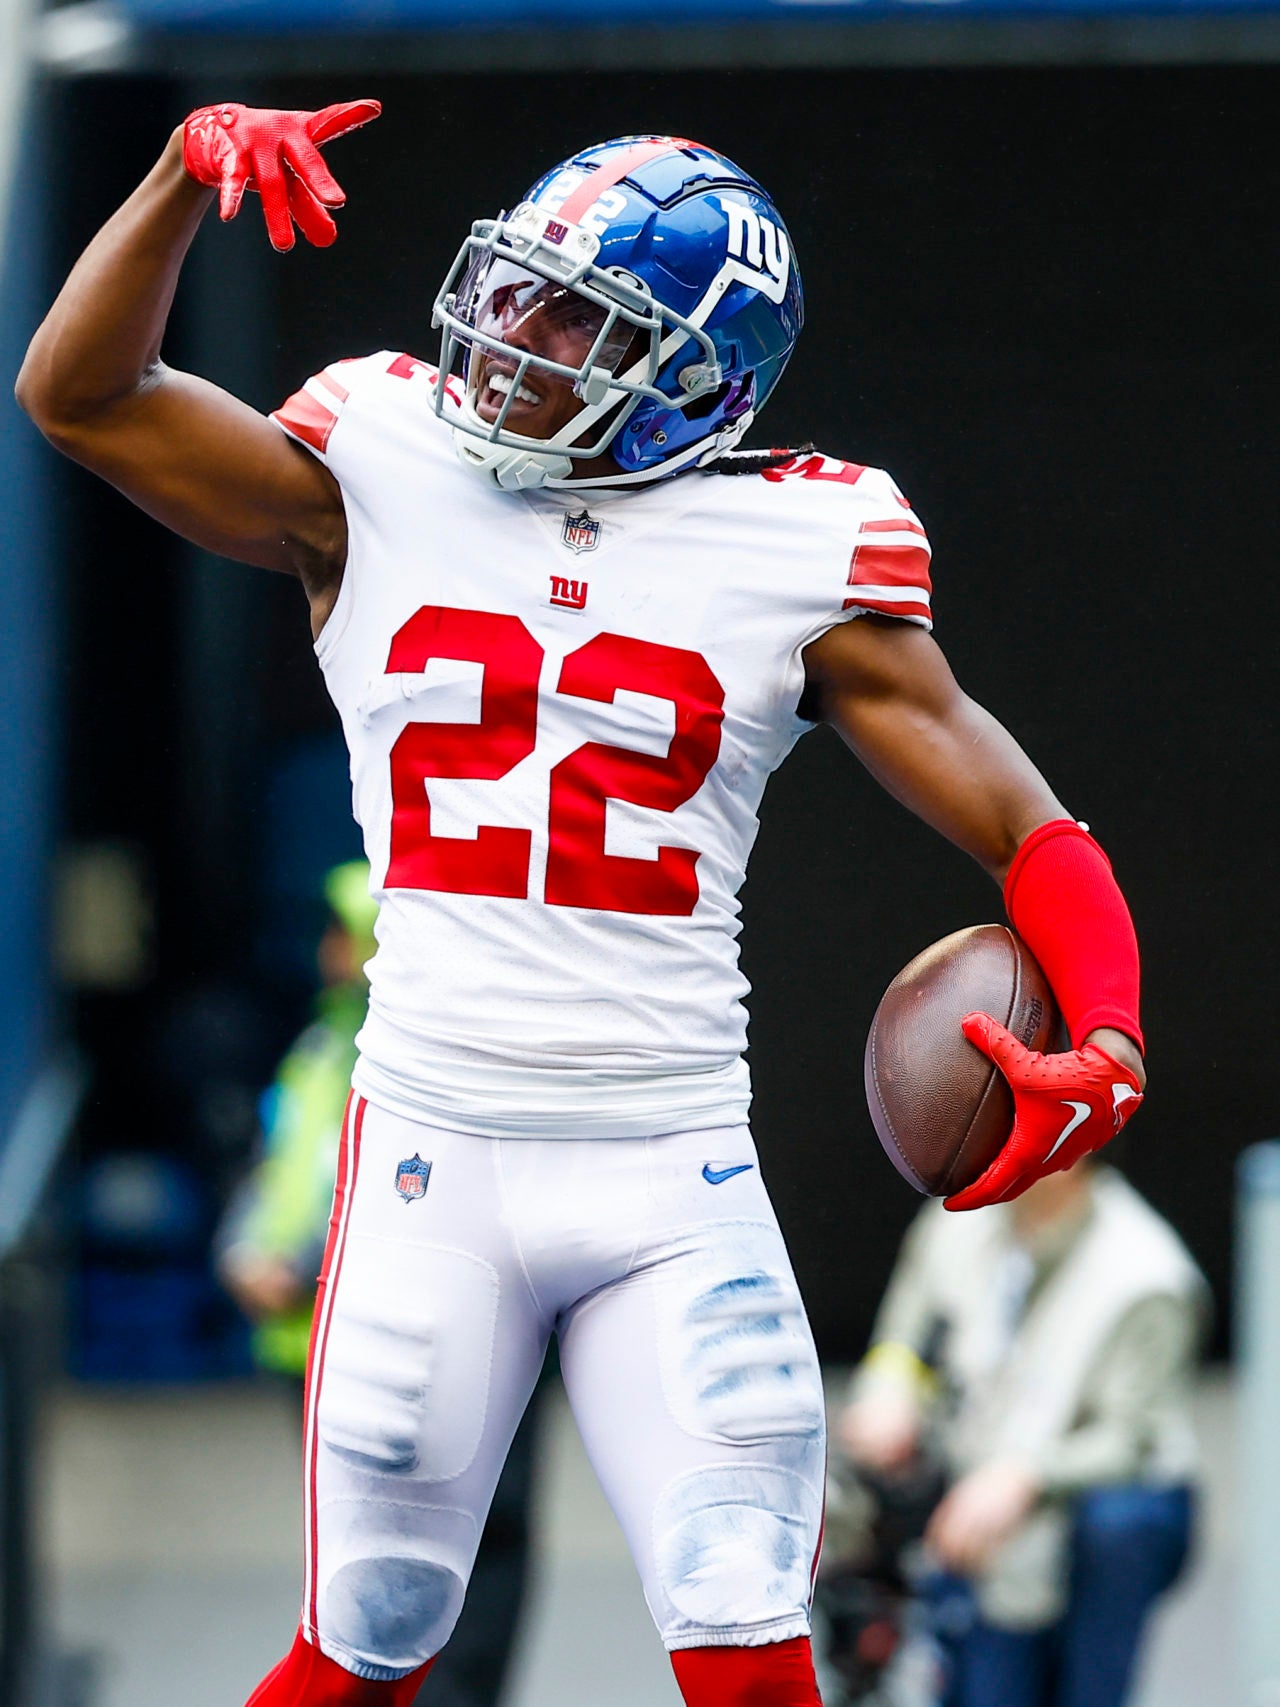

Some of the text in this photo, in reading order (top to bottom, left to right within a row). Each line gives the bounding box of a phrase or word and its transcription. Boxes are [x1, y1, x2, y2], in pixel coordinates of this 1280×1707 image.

[536, 170, 628, 237] 22
[720, 197, 790, 305] ny
[567, 527, 593, 545] NFL
[549, 575, 588, 610] ny
[384, 605, 726, 916] 22
